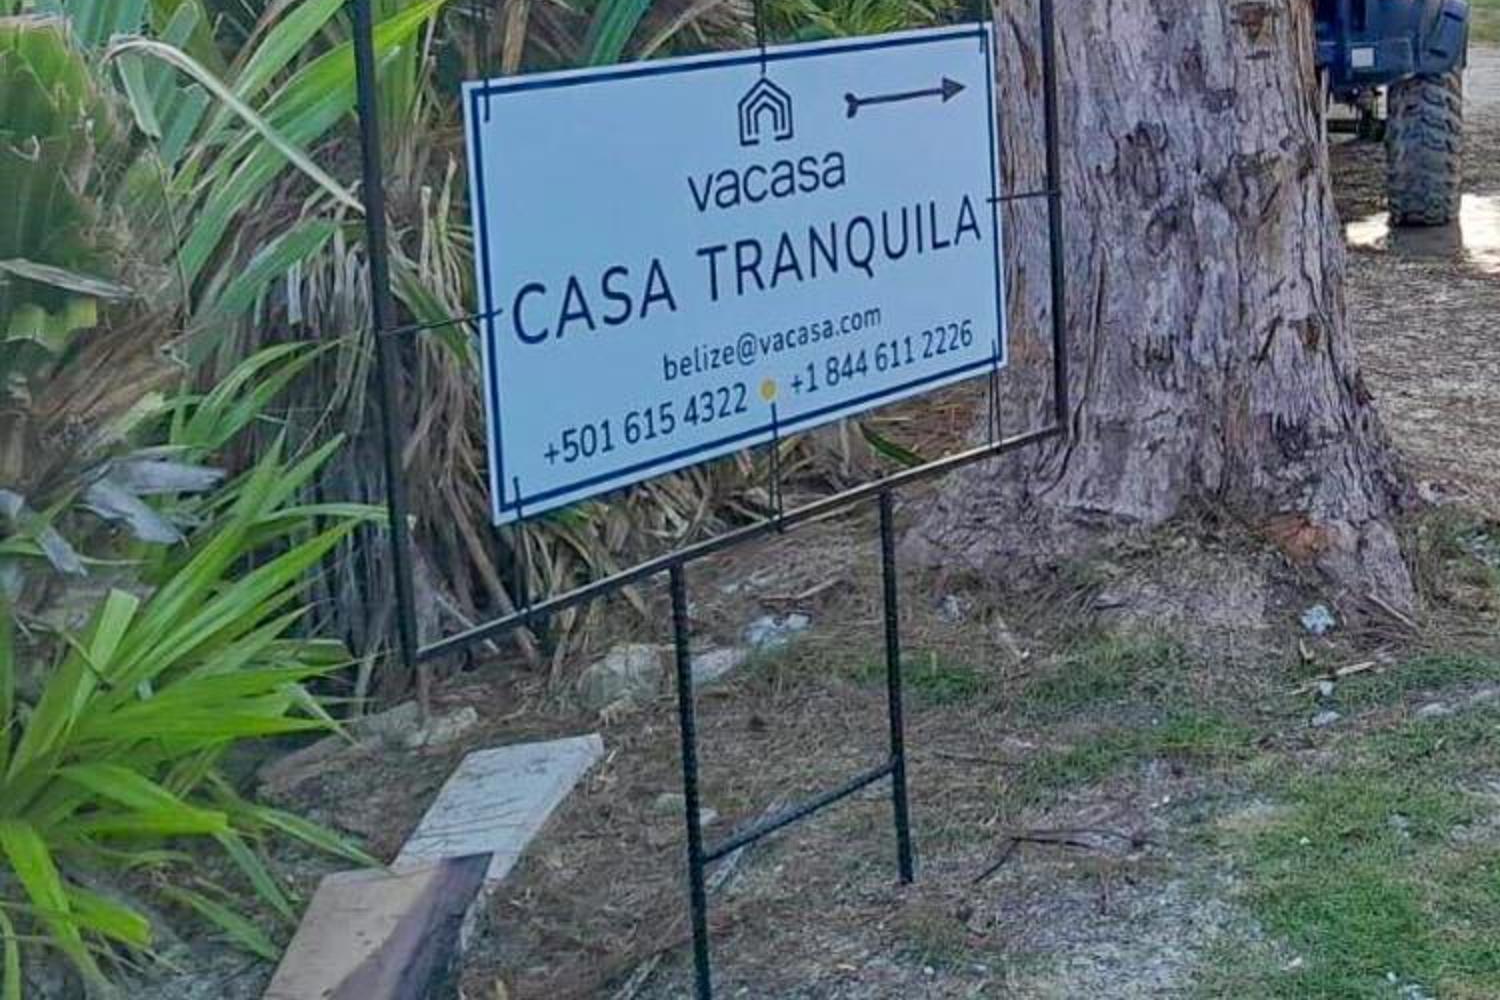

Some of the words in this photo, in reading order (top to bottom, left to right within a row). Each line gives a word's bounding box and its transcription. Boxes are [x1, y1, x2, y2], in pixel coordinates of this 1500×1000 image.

[687, 150, 846, 212] vacasa
[512, 258, 677, 345] CASA
[697, 194, 981, 302] TRANQUILA
[543, 419, 613, 466] +501
[623, 400, 674, 445] 615
[683, 381, 748, 426] 4322
[790, 361, 819, 394] +1
[825, 349, 868, 387] 844
[874, 335, 916, 372] 611
[921, 319, 973, 359] 2226
[662, 306, 882, 382] belize@vacasa.com
